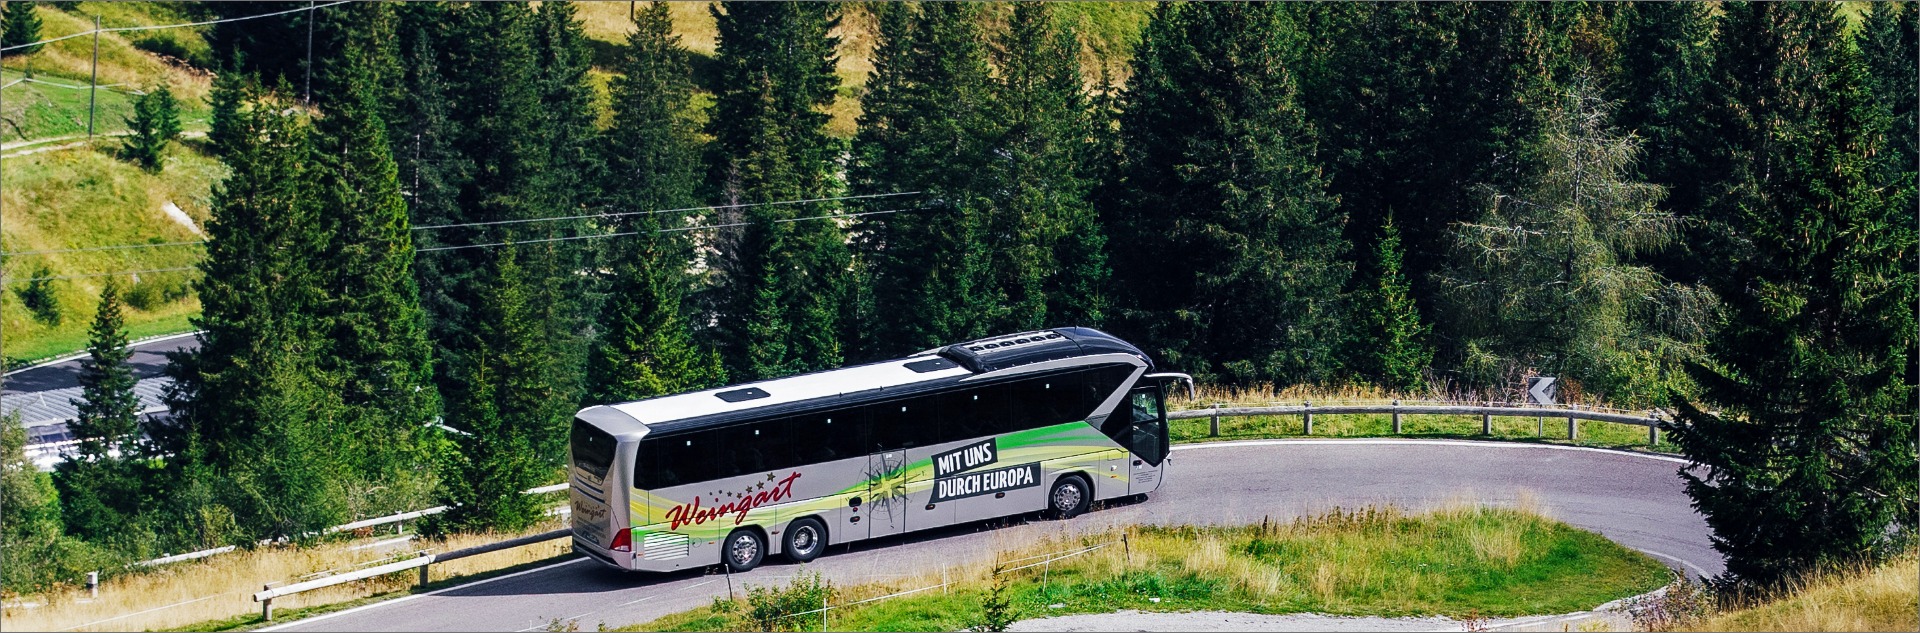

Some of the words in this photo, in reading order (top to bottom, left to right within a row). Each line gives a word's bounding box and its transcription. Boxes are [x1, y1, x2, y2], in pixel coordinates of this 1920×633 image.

[938, 450, 962, 476] MIT
[964, 442, 993, 467] UNS
[938, 474, 981, 499] DURCH
[983, 466, 1034, 491] EUROPA
[665, 471, 802, 531] Weingart
